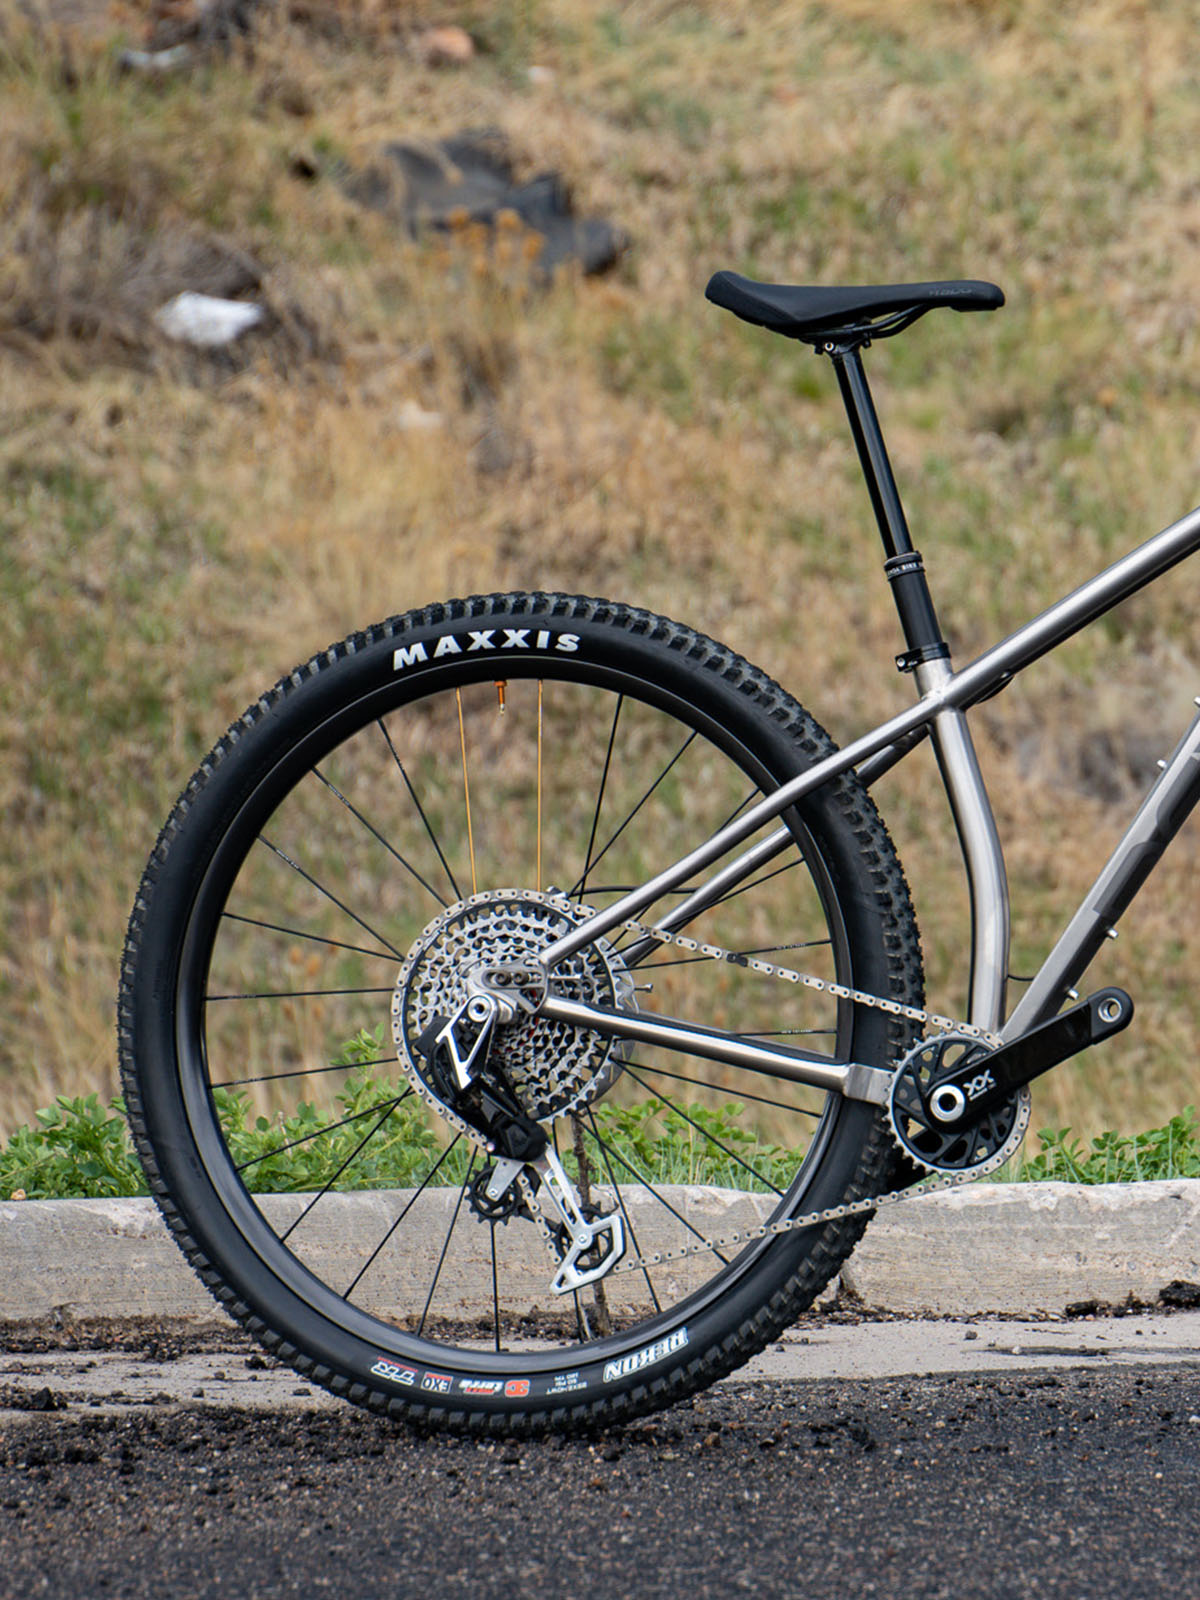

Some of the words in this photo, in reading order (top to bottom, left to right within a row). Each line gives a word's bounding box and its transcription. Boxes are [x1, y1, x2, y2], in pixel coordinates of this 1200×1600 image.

[393, 628, 582, 671] MAXXIS
[603, 1326, 689, 1383] REKON
[422, 1376, 450, 1393] EXO
